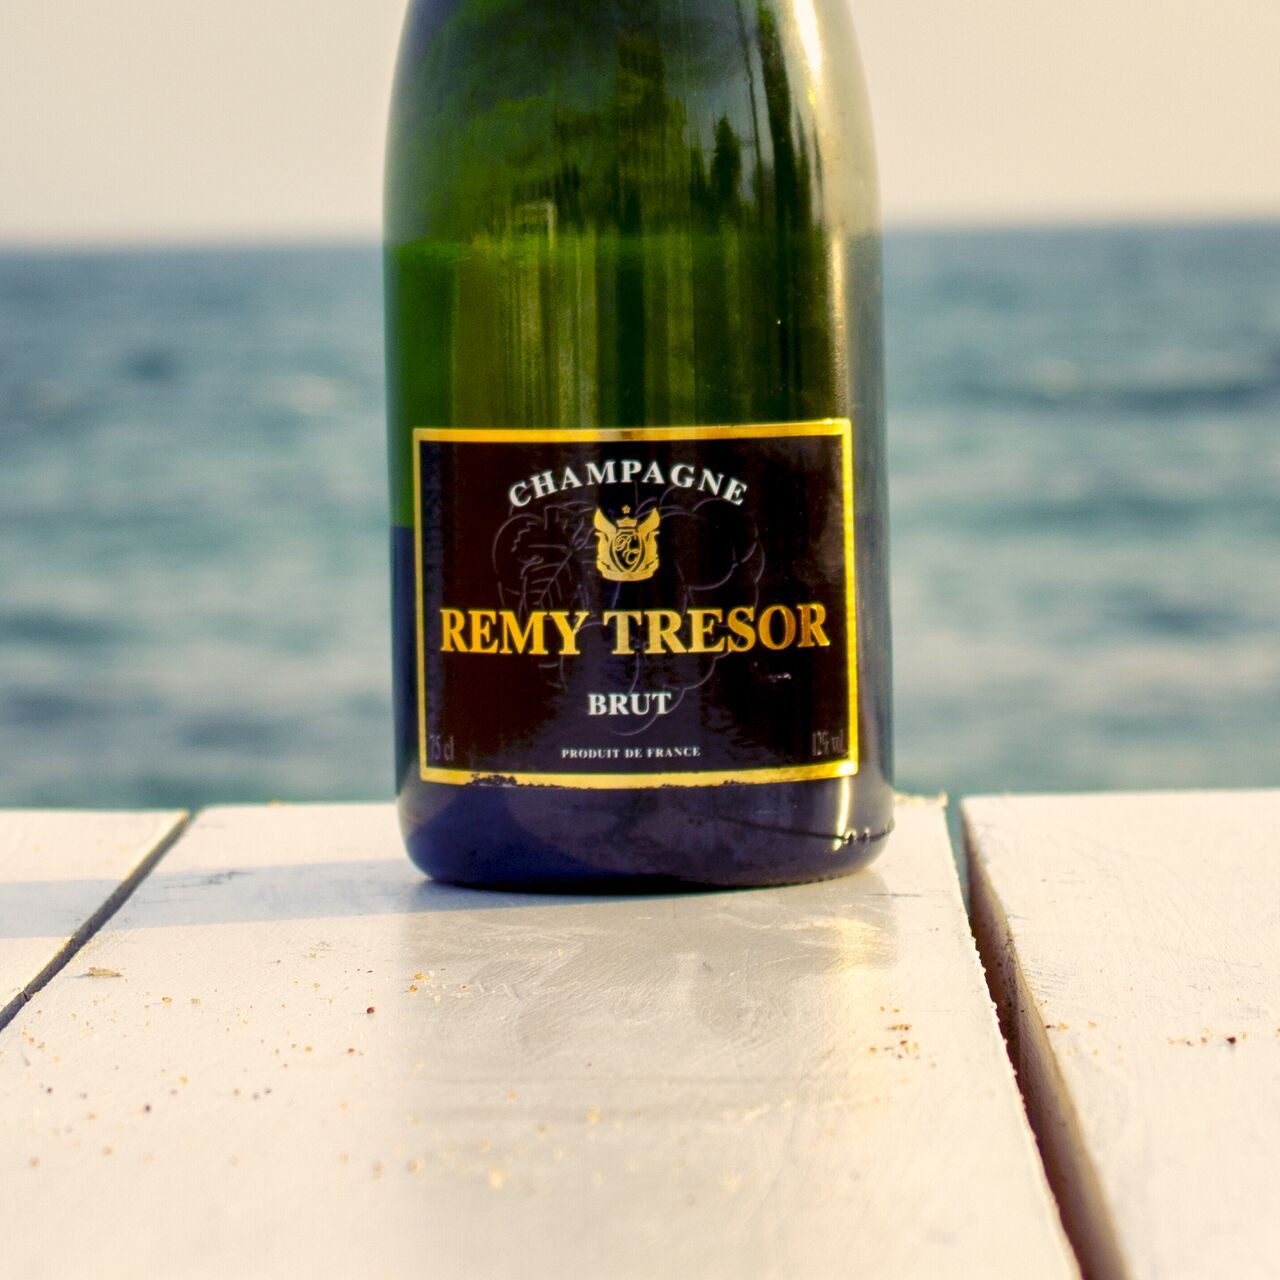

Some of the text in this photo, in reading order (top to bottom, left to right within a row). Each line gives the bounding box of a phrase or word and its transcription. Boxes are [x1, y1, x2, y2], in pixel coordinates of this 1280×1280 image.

[508, 460, 748, 508] CHAMPAGNE
[439, 603, 831, 656] REMY TRESOR
[588, 691, 672, 716] BRUT
[561, 746, 701, 759] PRODUIT DE FRANCE
